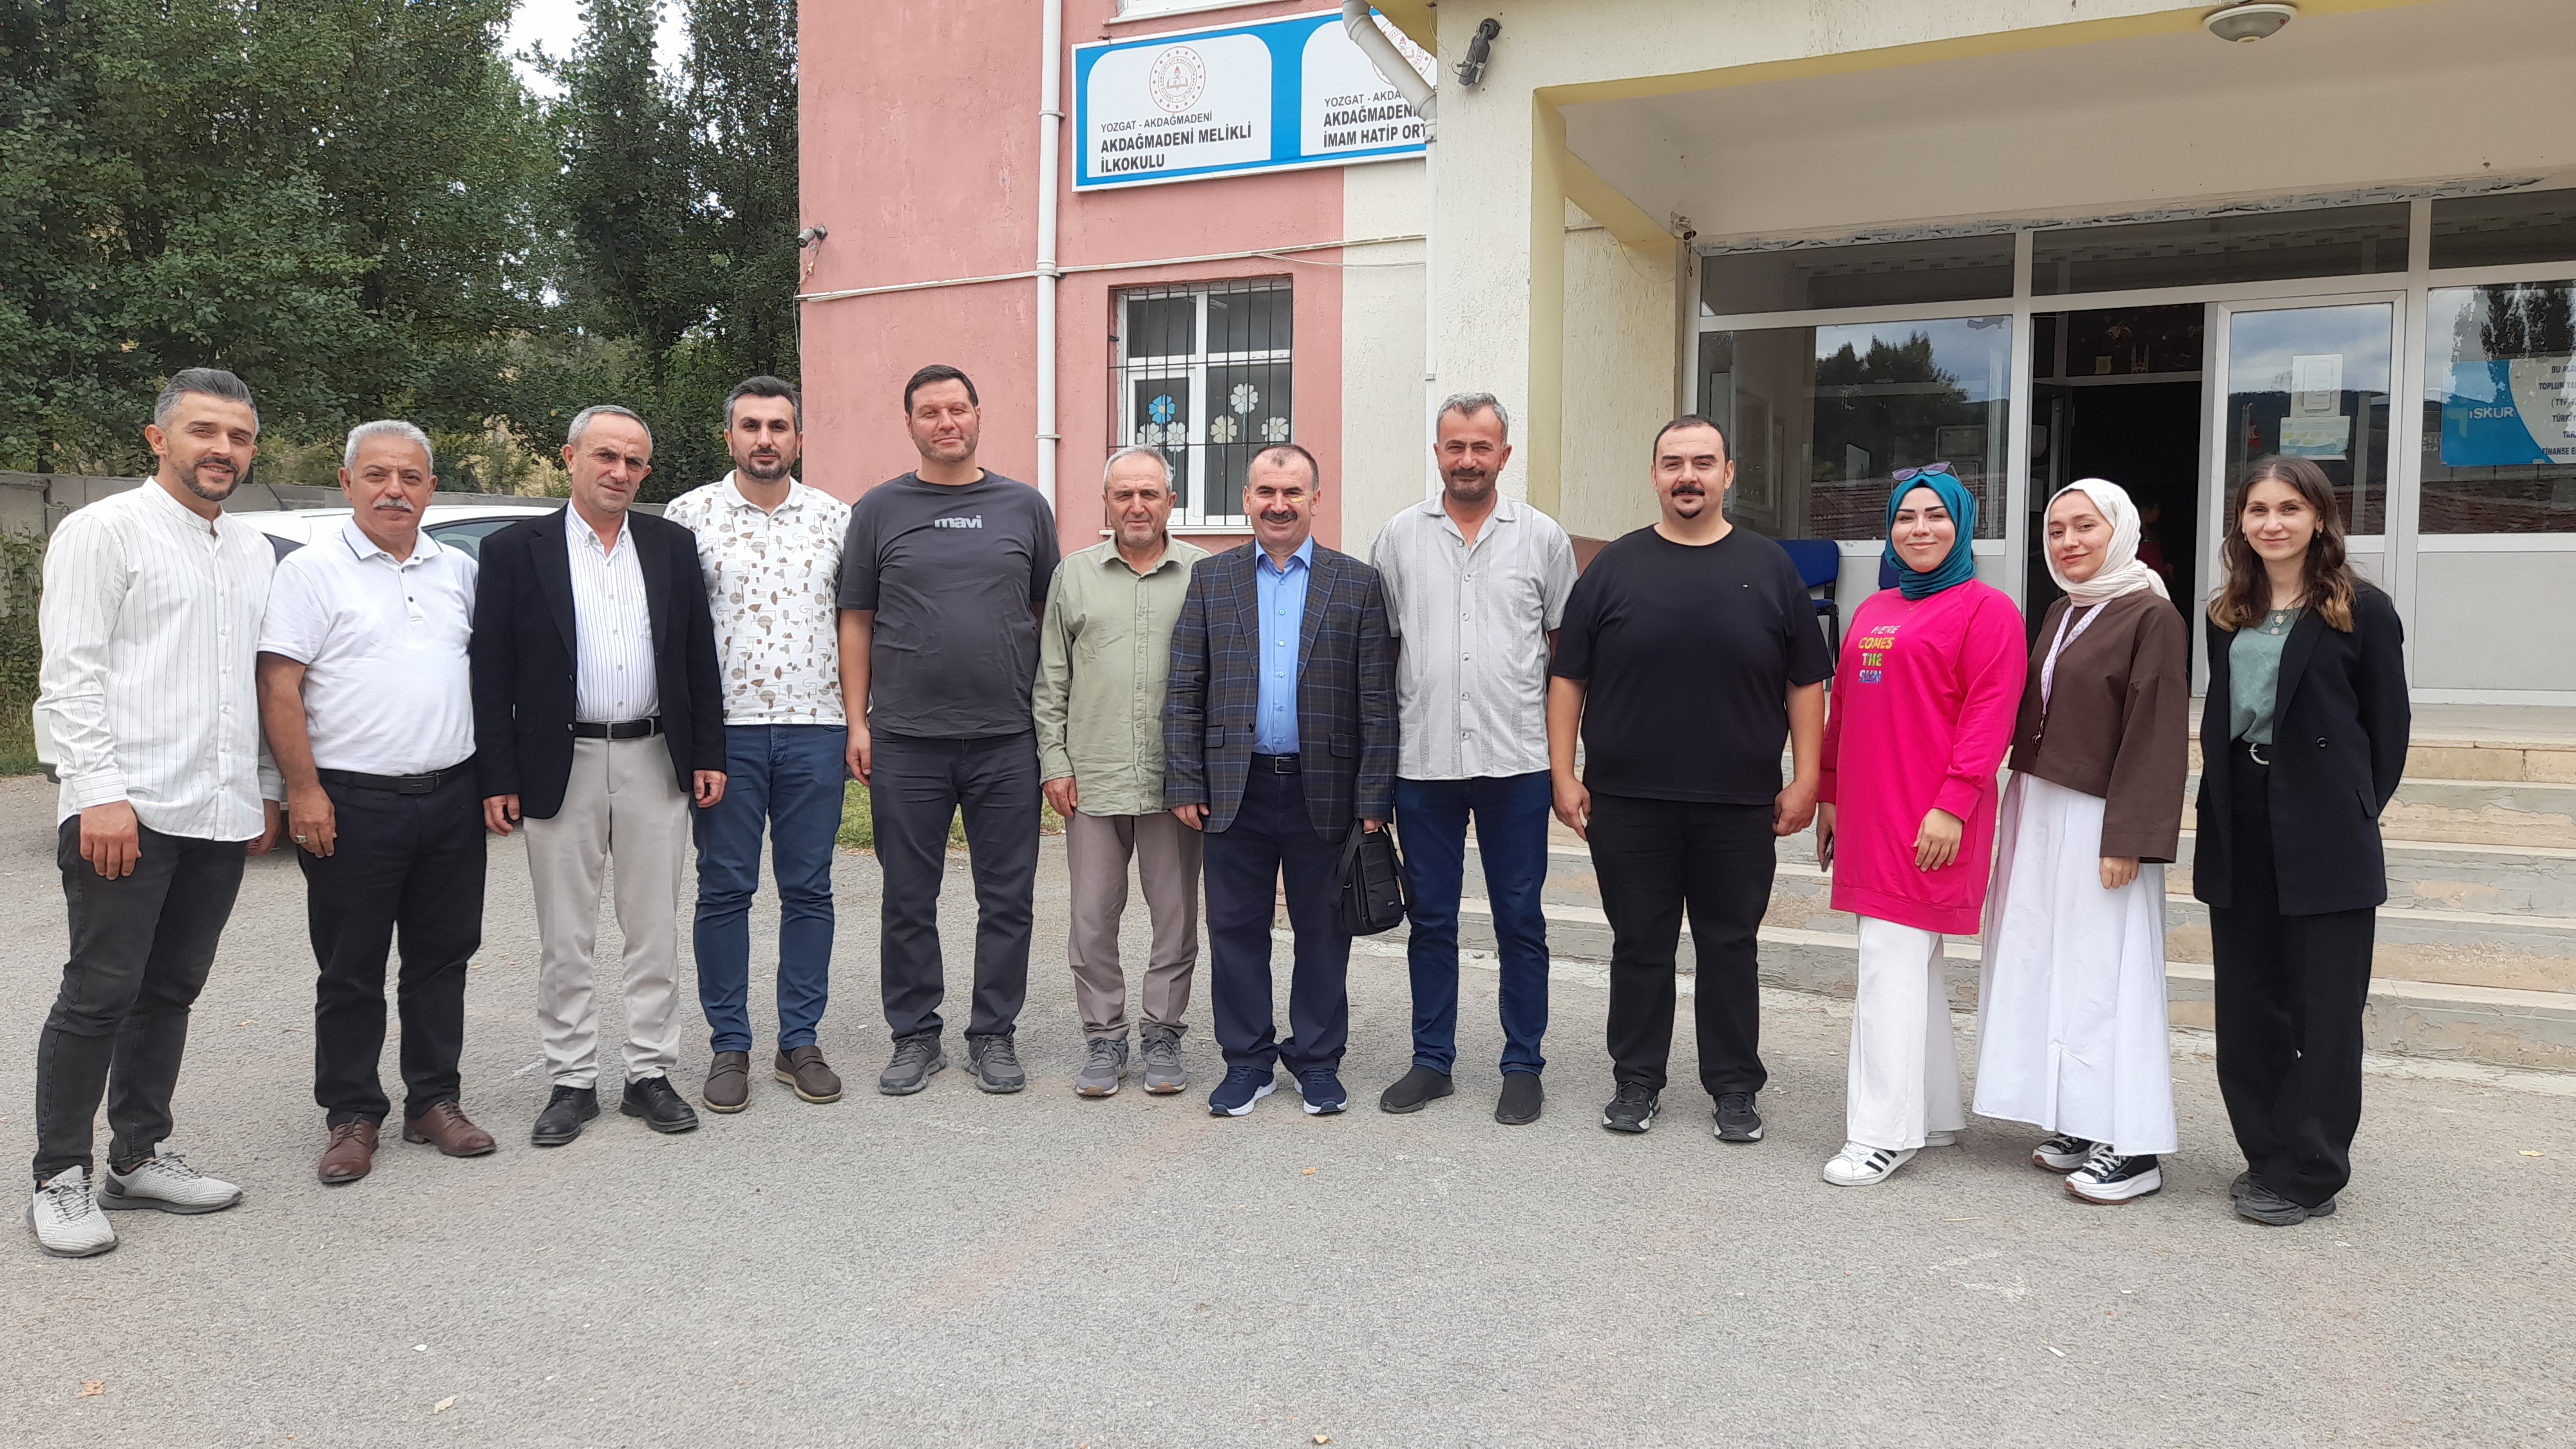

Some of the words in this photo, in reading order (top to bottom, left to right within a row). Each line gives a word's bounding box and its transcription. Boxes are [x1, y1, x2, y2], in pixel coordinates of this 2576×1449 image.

[1324, 93, 1364, 108] YOZGAT
[1372, 90, 1402, 102] AKDA
[1101, 120, 1137, 133] YOZGAT
[1144, 110, 1213, 128] AKDAĞMADENİ
[1100, 127, 1194, 153] AKDAĞMADENİ
[1198, 120, 1251, 144] MELİKLİ
[1323, 130, 1356, 147] İMAM
[1361, 123, 1398, 144] HATİP
[1402, 123, 1426, 139] ORT
[1101, 153, 1164, 173] İLKOKULU
[2552, 365, 2561, 374] BU
[2539, 381, 2565, 390] TOPLUM
[2542, 446, 2570, 455] FİNANSE
[934, 515, 982, 529] mavi
[1858, 636, 1895, 649] COMES
[1862, 652, 1883, 667] THE
